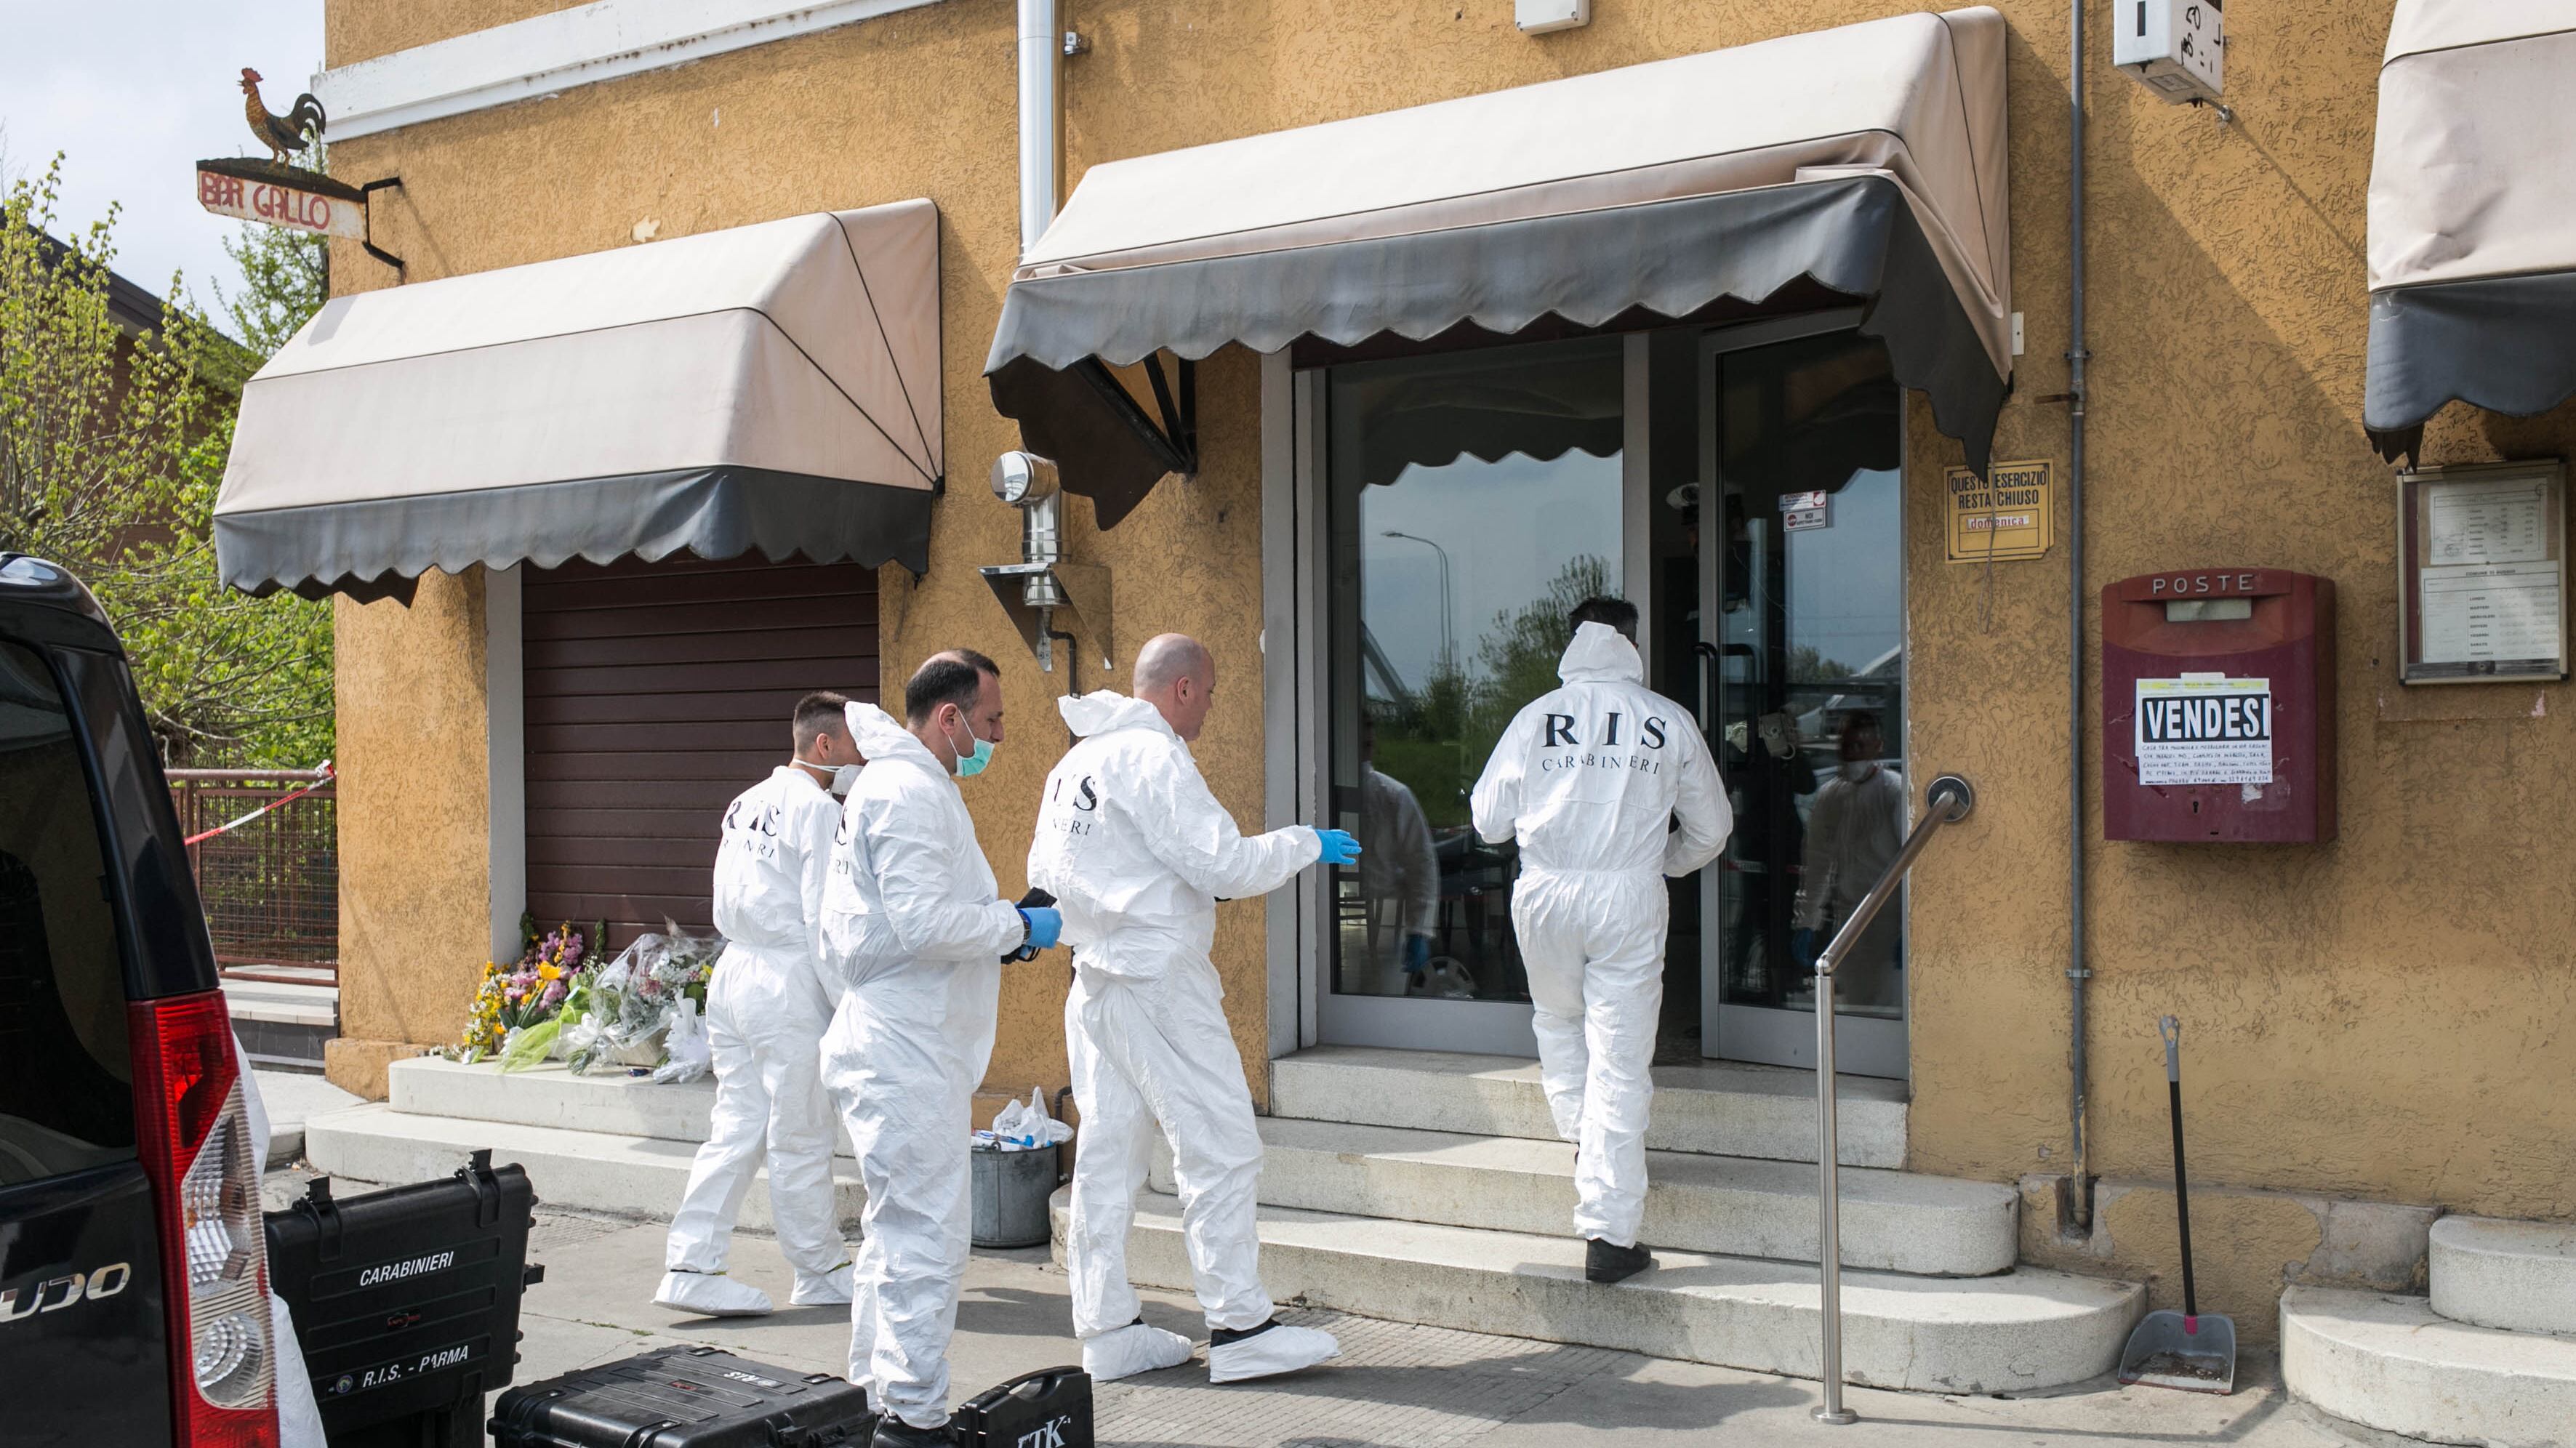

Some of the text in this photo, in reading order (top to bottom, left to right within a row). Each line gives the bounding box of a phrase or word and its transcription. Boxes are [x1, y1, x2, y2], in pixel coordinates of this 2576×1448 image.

[201, 173, 331, 230] BAR GALLO
[1995, 470, 2047, 489] ESERCIZIO
[1959, 489, 2039, 509] RESTA CHIUSO
[1970, 516, 2024, 529] domenica
[2151, 574, 2254, 595] POSTE
[1541, 712, 1666, 749] RIS
[2146, 697, 2269, 739] VENDESI
[1542, 753, 1660, 775] CRBINERI
[359, 1251, 454, 1287] CARABINIERI
[0, 1262, 131, 1323] UDO
[363, 1364, 401, 1388] R.I.S.
[419, 1345, 469, 1372] PARMA
